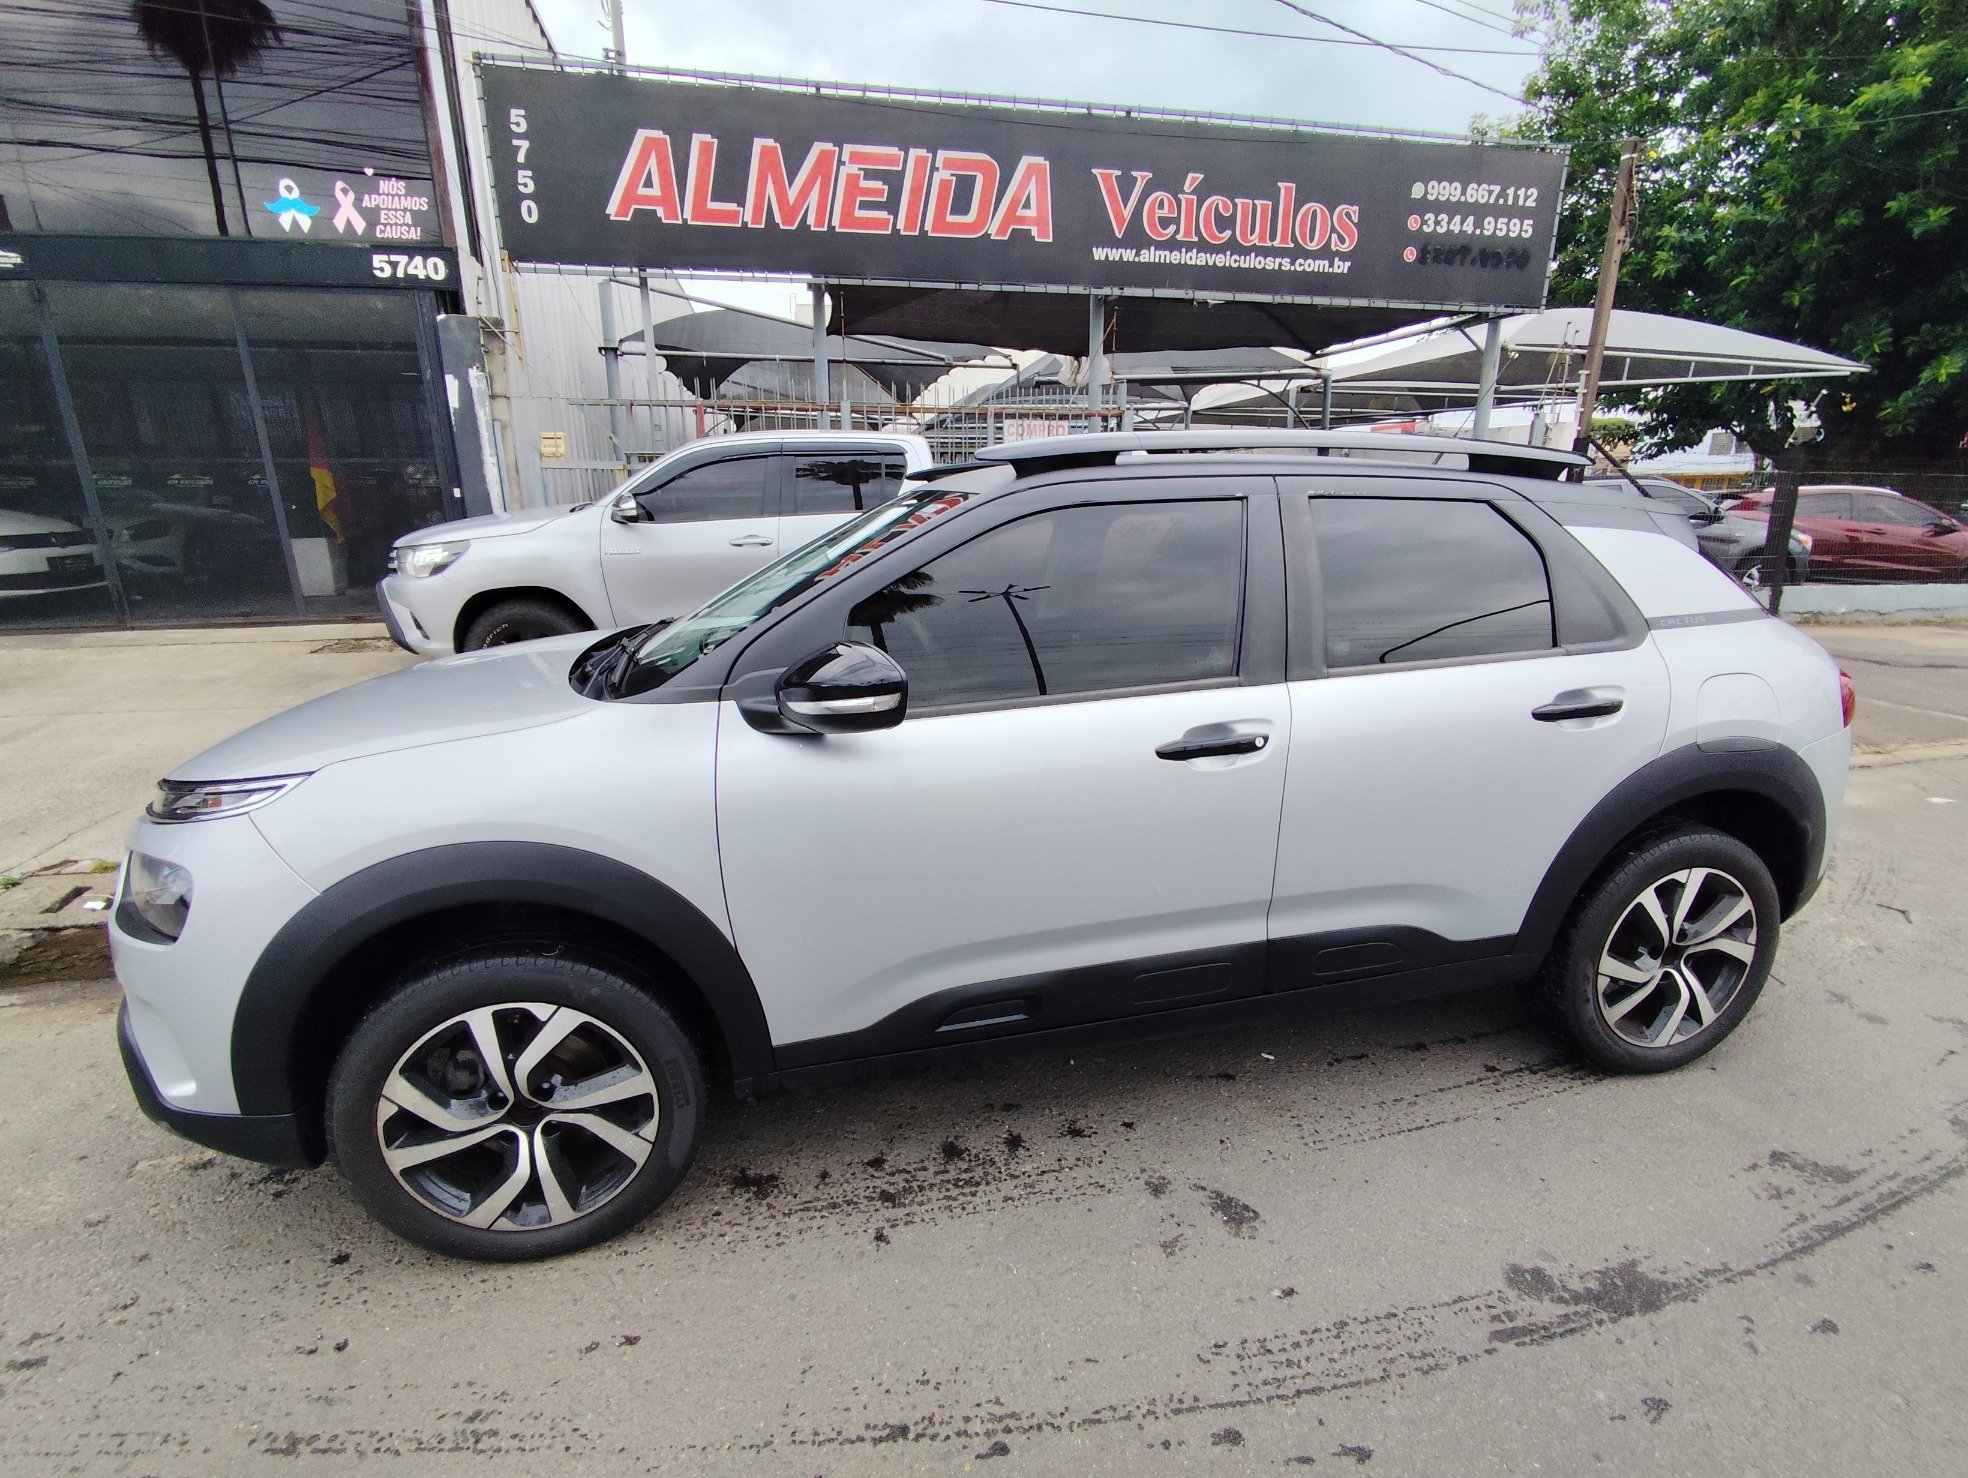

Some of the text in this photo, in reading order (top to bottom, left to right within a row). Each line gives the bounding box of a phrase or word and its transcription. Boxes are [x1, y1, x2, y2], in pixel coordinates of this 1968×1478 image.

[379, 178, 406, 195] NÓS
[605, 128, 1360, 252] ALMEIDA Veículos
[1426, 180, 1539, 207] 999.667.112
[362, 194, 428, 211] APOIAMOS
[380, 210, 412, 225] ESSA
[1422, 212, 1534, 238] 3344.9595
[375, 225, 421, 240] CAUSA!
[372, 254, 446, 280] 5740
[1092, 244, 1352, 274] www.almeidaveiculosrs.com.br
[1007, 423, 1066, 437] COMPRO
[1660, 615, 1706, 627] CACTUS
